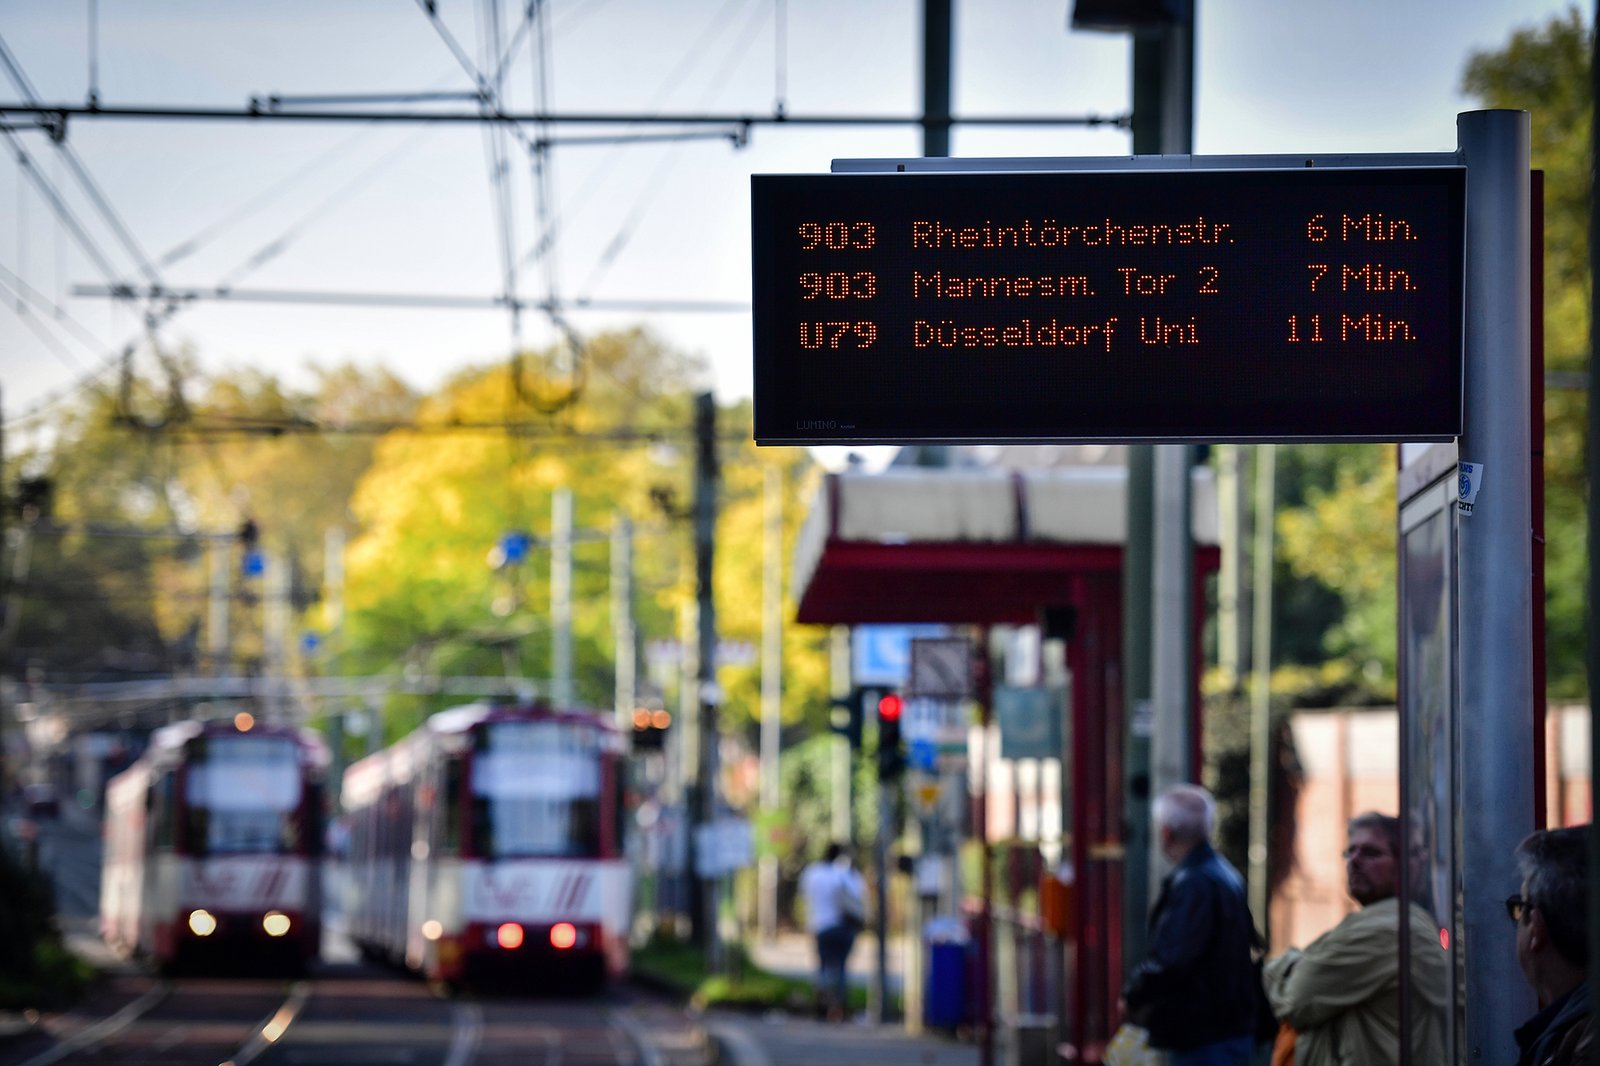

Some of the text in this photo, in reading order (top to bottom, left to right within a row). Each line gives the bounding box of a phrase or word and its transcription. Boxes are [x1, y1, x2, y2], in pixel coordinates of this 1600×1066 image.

[799, 213, 1418, 250] 903 Rheintörchenstr. 6 Min.
[799, 263, 1418, 299] 903 Mannesm. Tor 2 7 Min.
[801, 313, 1418, 352] U79 Düsseldorf Uni 11 Min.
[796, 419, 837, 430] LUMINO
